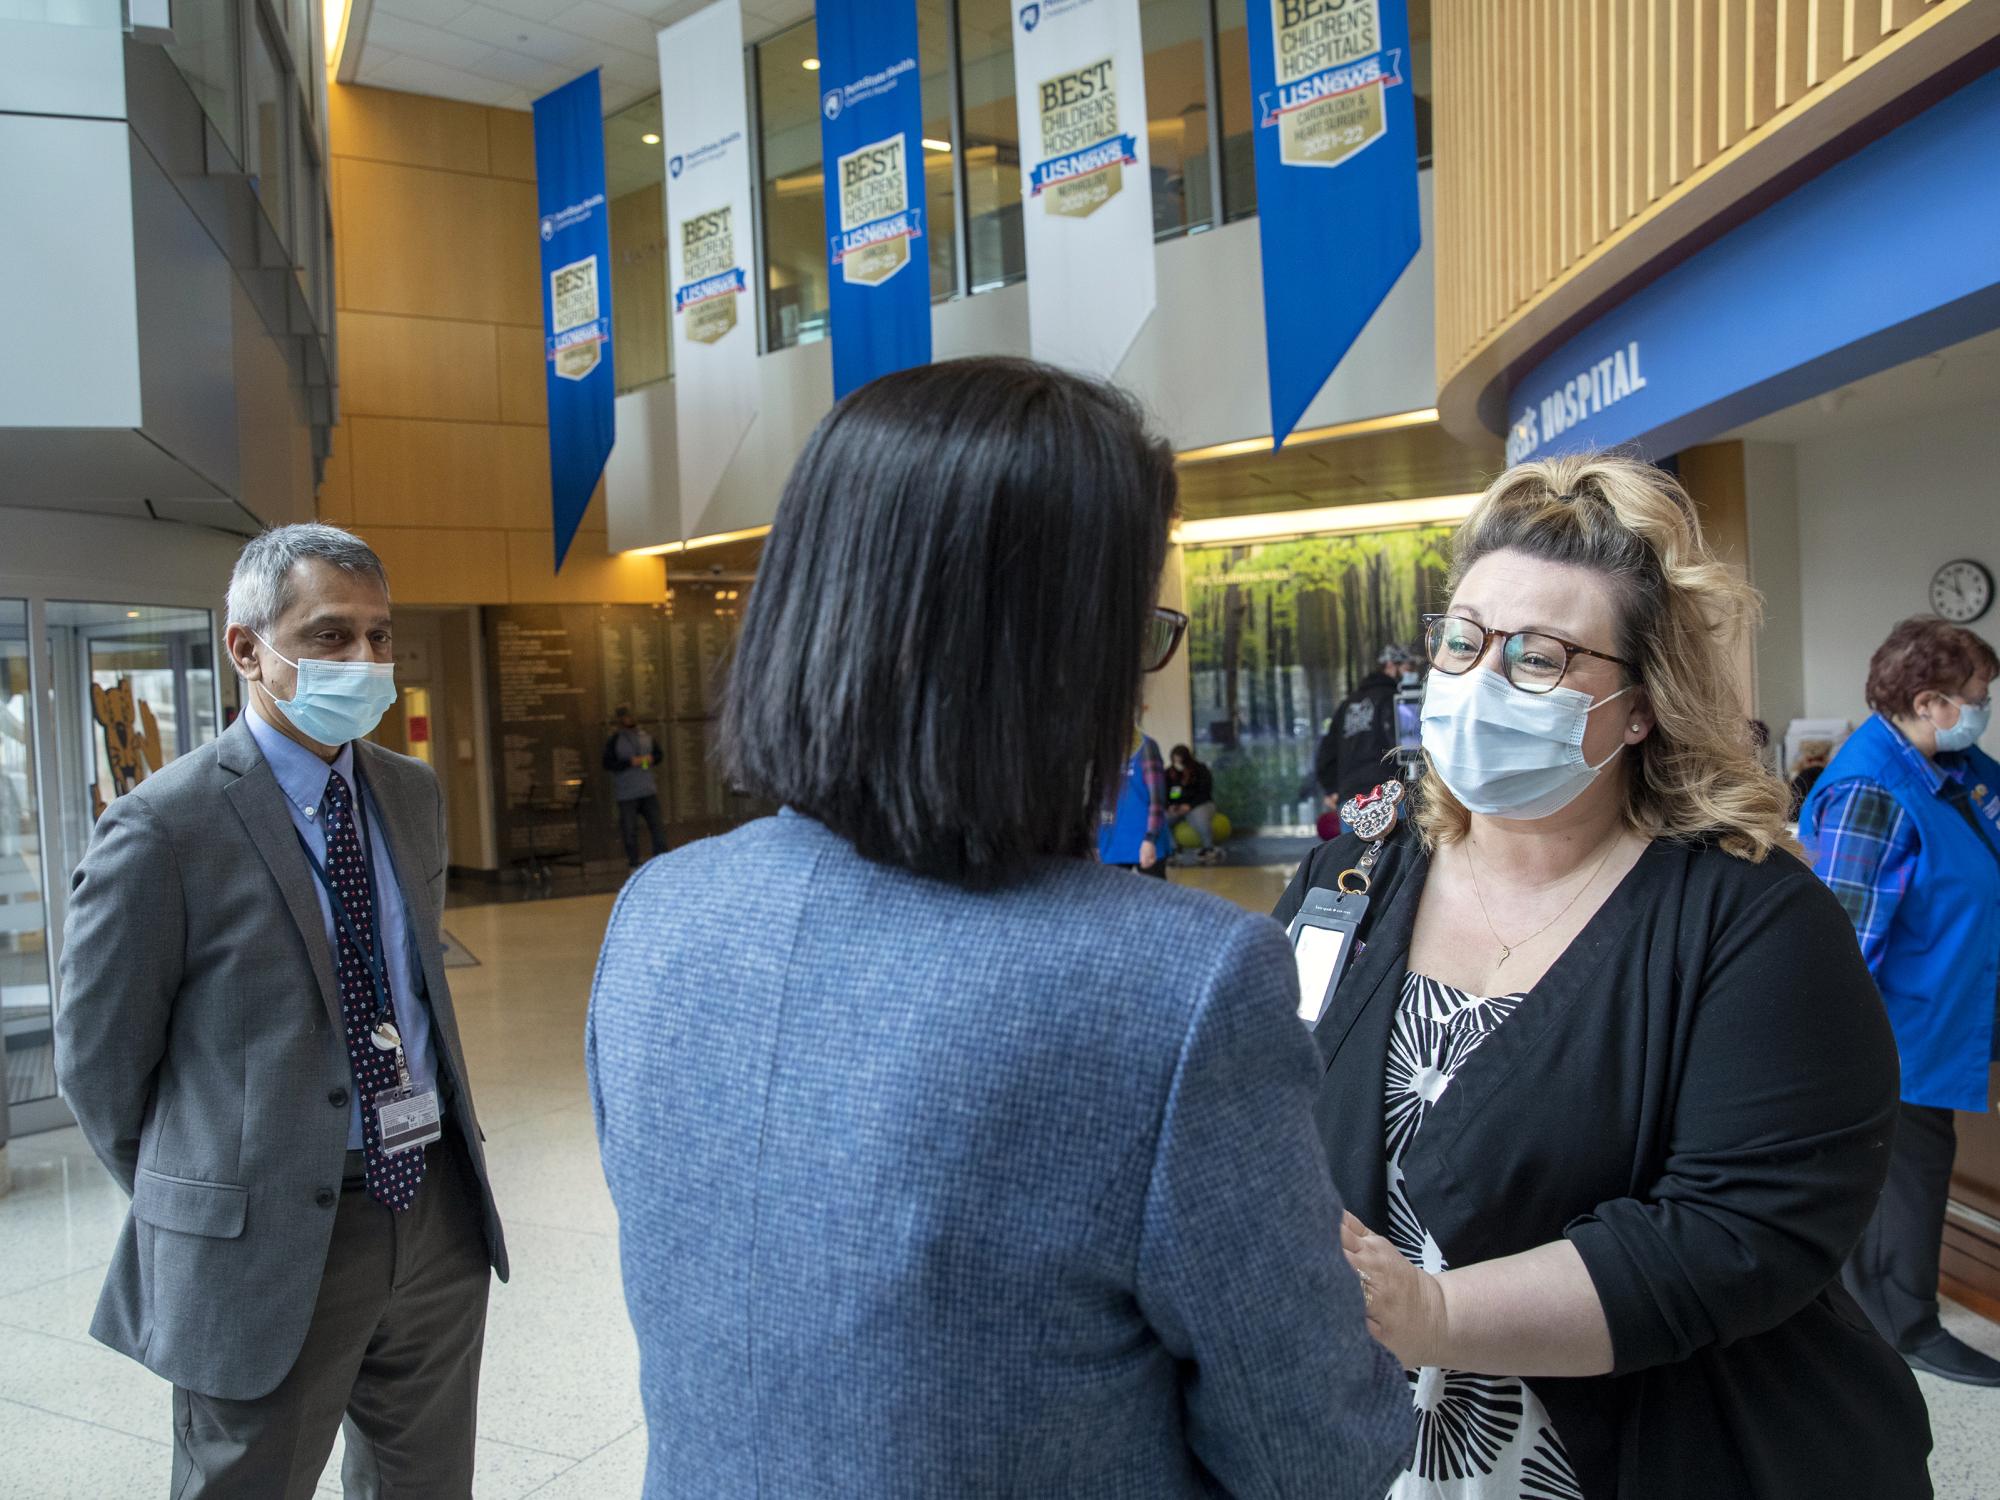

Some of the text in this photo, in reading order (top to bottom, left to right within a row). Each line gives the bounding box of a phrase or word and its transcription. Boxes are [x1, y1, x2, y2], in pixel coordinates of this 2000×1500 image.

[1280, 0, 1362, 30] BE
[1281, 3, 1373, 54] CHILDREN'S
[1282, 28, 1374, 78] HOSPITALS
[1041, 59, 1112, 113] BEST
[1042, 92, 1116, 135] CHILDREN'S
[1043, 114, 1118, 156] HOSPITALS
[845, 142, 900, 188] BEST
[683, 206, 731, 247] BEST
[555, 262, 593, 297] BEST
[1541, 341, 1647, 443] HOSPITAL
